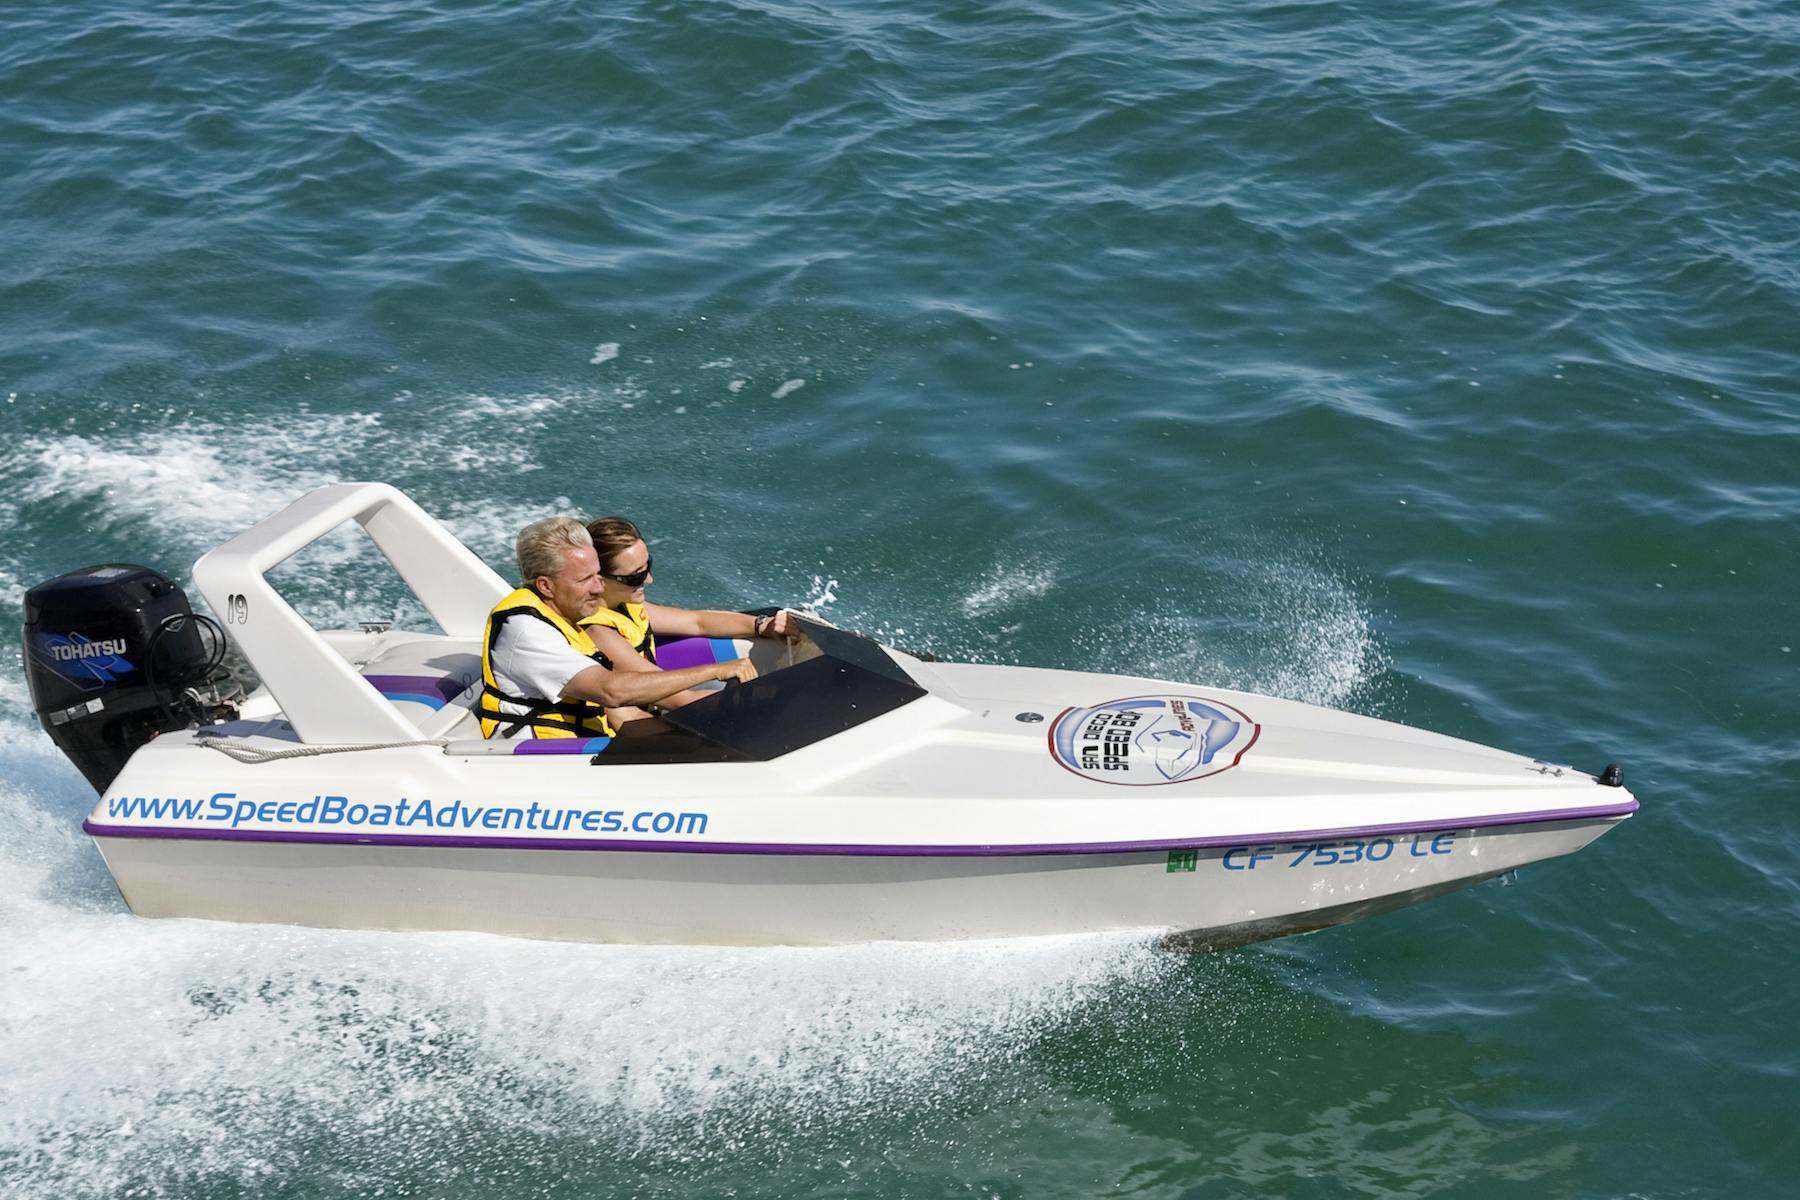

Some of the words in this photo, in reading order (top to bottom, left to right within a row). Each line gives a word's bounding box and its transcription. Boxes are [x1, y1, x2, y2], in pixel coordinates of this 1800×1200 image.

[227, 593, 249, 625] 19
[51, 638, 127, 661] TOHATSU
[462, 672, 474, 701] 8
[1083, 713, 1114, 740] DIEGO
[1081, 745, 1100, 770] SAN
[1103, 728, 1132, 771] SPEED
[108, 793, 708, 834] www.SpeedBoatAdventures.com
[1222, 847, 1275, 870] CF
[1288, 838, 1394, 868] 7530
[1410, 832, 1457, 857] LE
